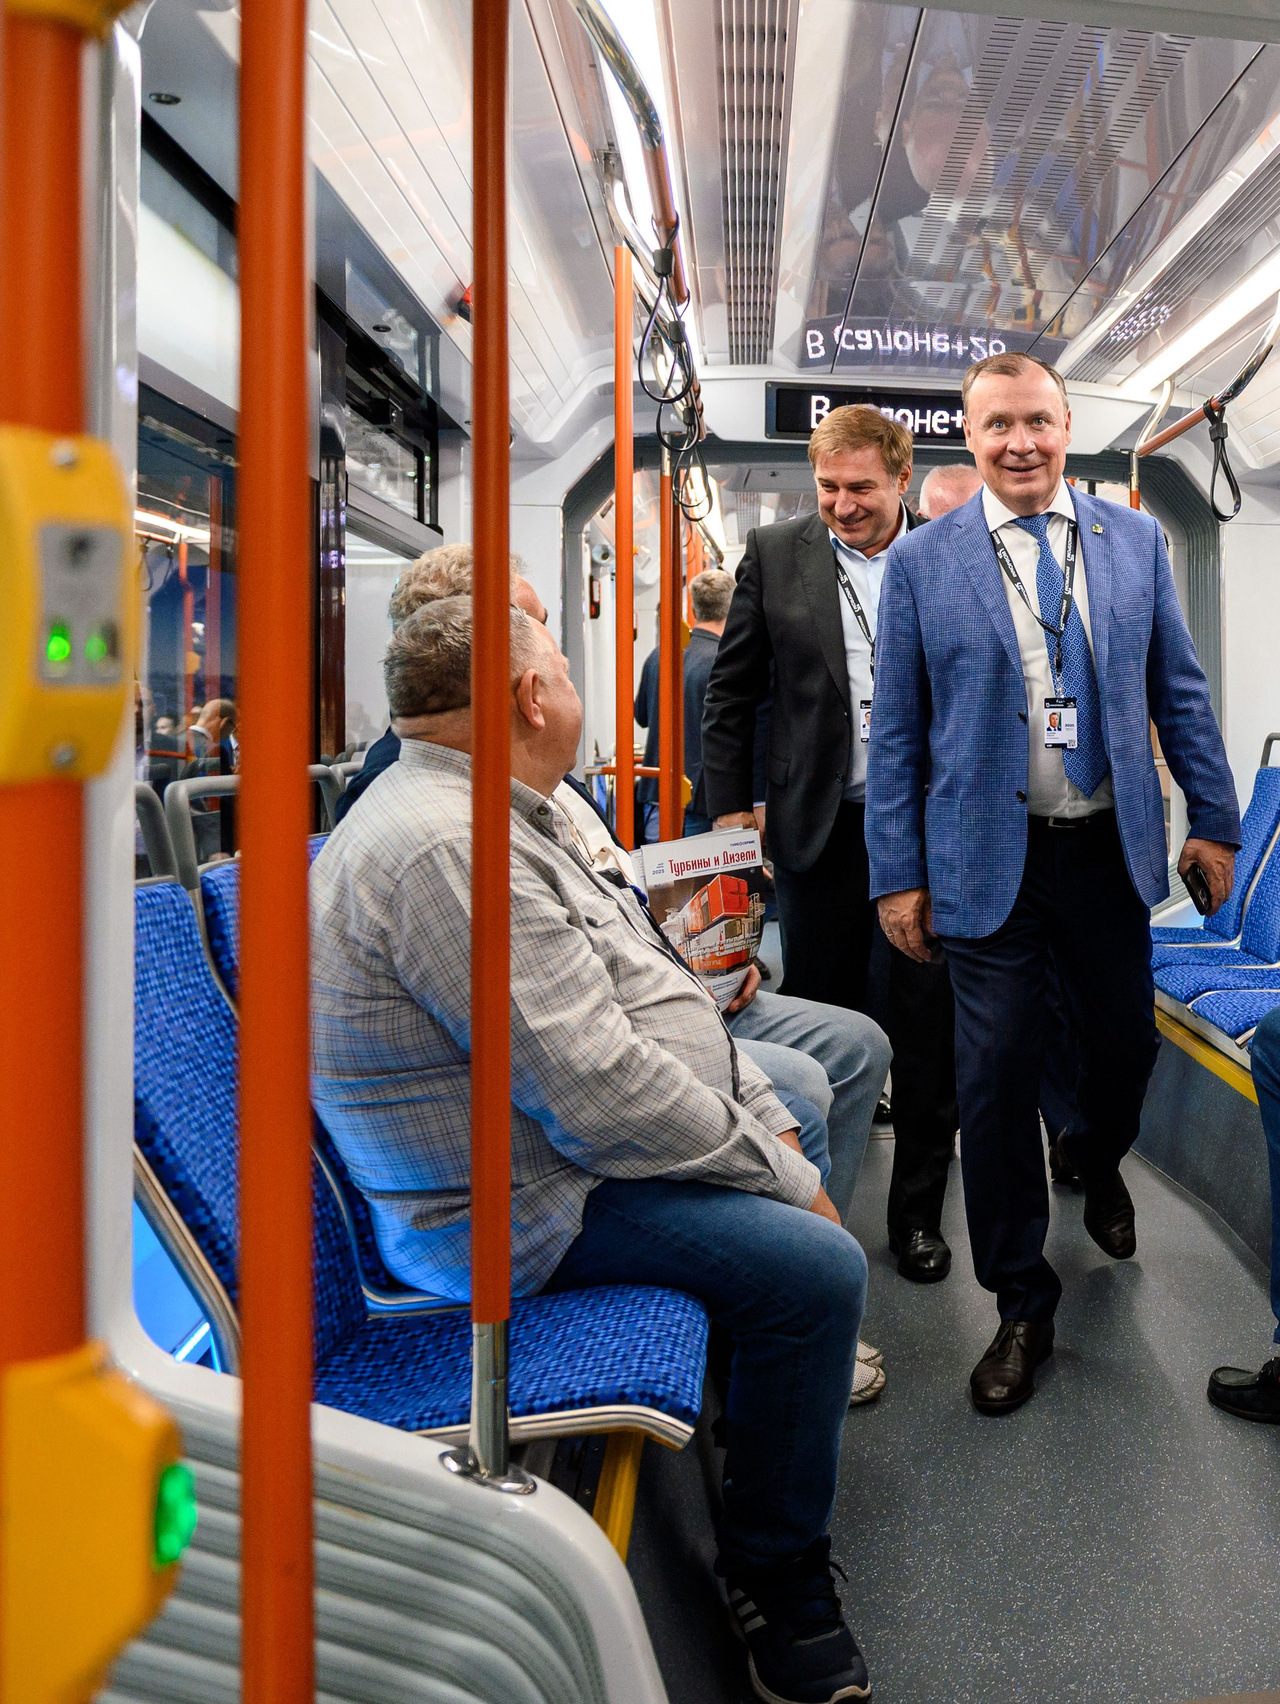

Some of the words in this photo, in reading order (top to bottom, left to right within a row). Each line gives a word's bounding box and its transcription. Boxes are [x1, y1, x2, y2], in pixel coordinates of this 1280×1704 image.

[811, 395, 830, 429] В
[668, 857, 711, 877] Турбины
[714, 856, 720, 867] и
[722, 849, 757, 866] Дизели
